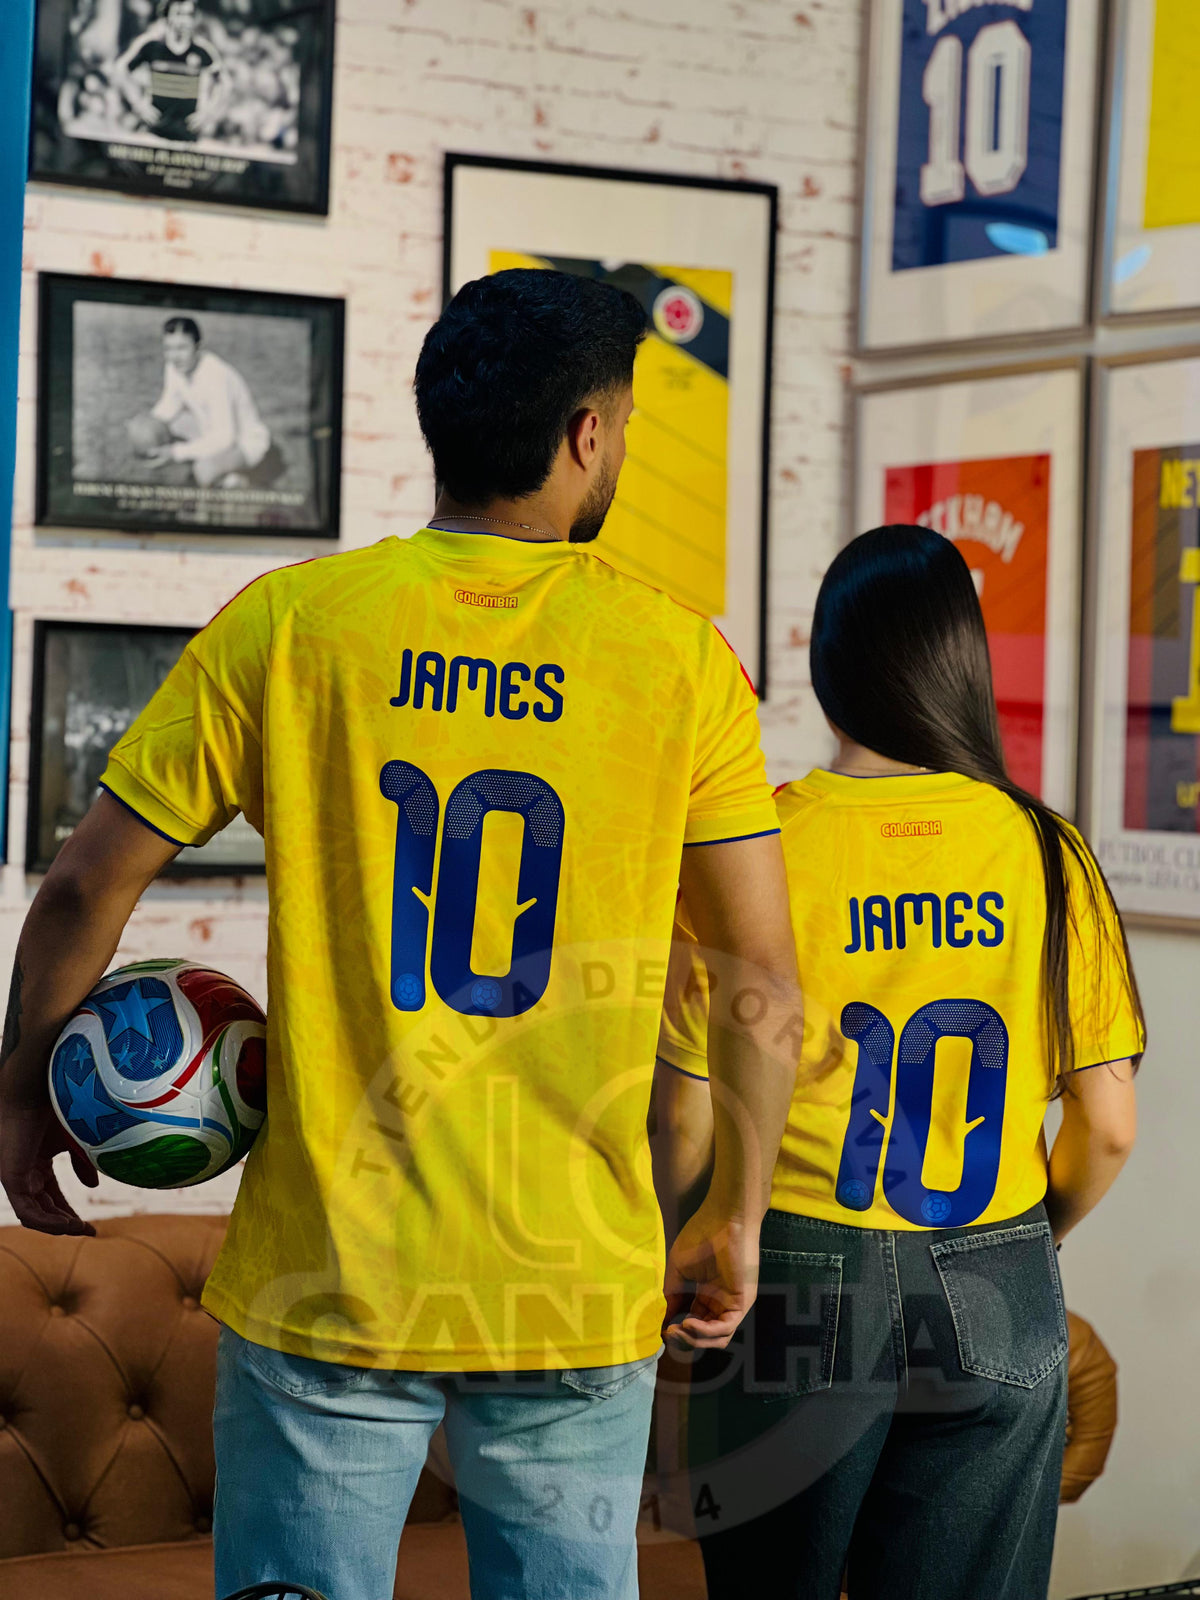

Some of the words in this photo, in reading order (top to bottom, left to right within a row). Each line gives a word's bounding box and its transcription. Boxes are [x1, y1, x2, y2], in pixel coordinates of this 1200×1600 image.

[920, 19, 1032, 207] 10
[1160, 459, 1200, 509] NE
[454, 589, 519, 609] COLOMBIA
[389, 648, 565, 723] JAMES
[880, 820, 942, 838] COLOMBIA
[379, 758, 566, 1019] 10
[844, 891, 1005, 954] JAMES
[835, 998, 1010, 1230] 10
